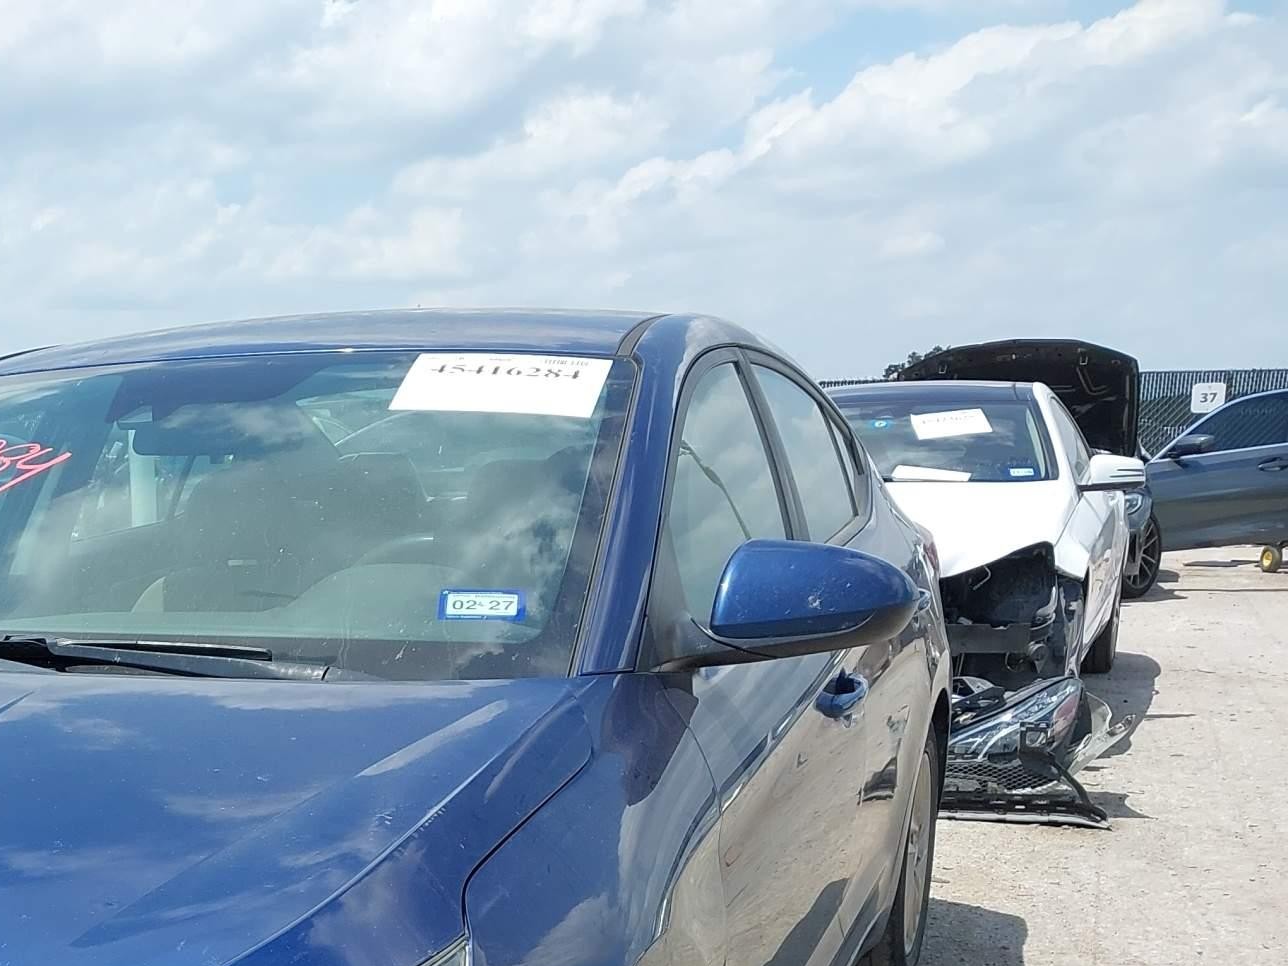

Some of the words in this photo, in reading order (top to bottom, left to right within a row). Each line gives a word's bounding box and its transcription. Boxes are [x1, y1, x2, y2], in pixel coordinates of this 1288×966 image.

[431, 363, 581, 380] 45416284
[1199, 392, 1218, 403] 37
[452, 599, 478, 610] 02
[488, 600, 515, 611] 27
